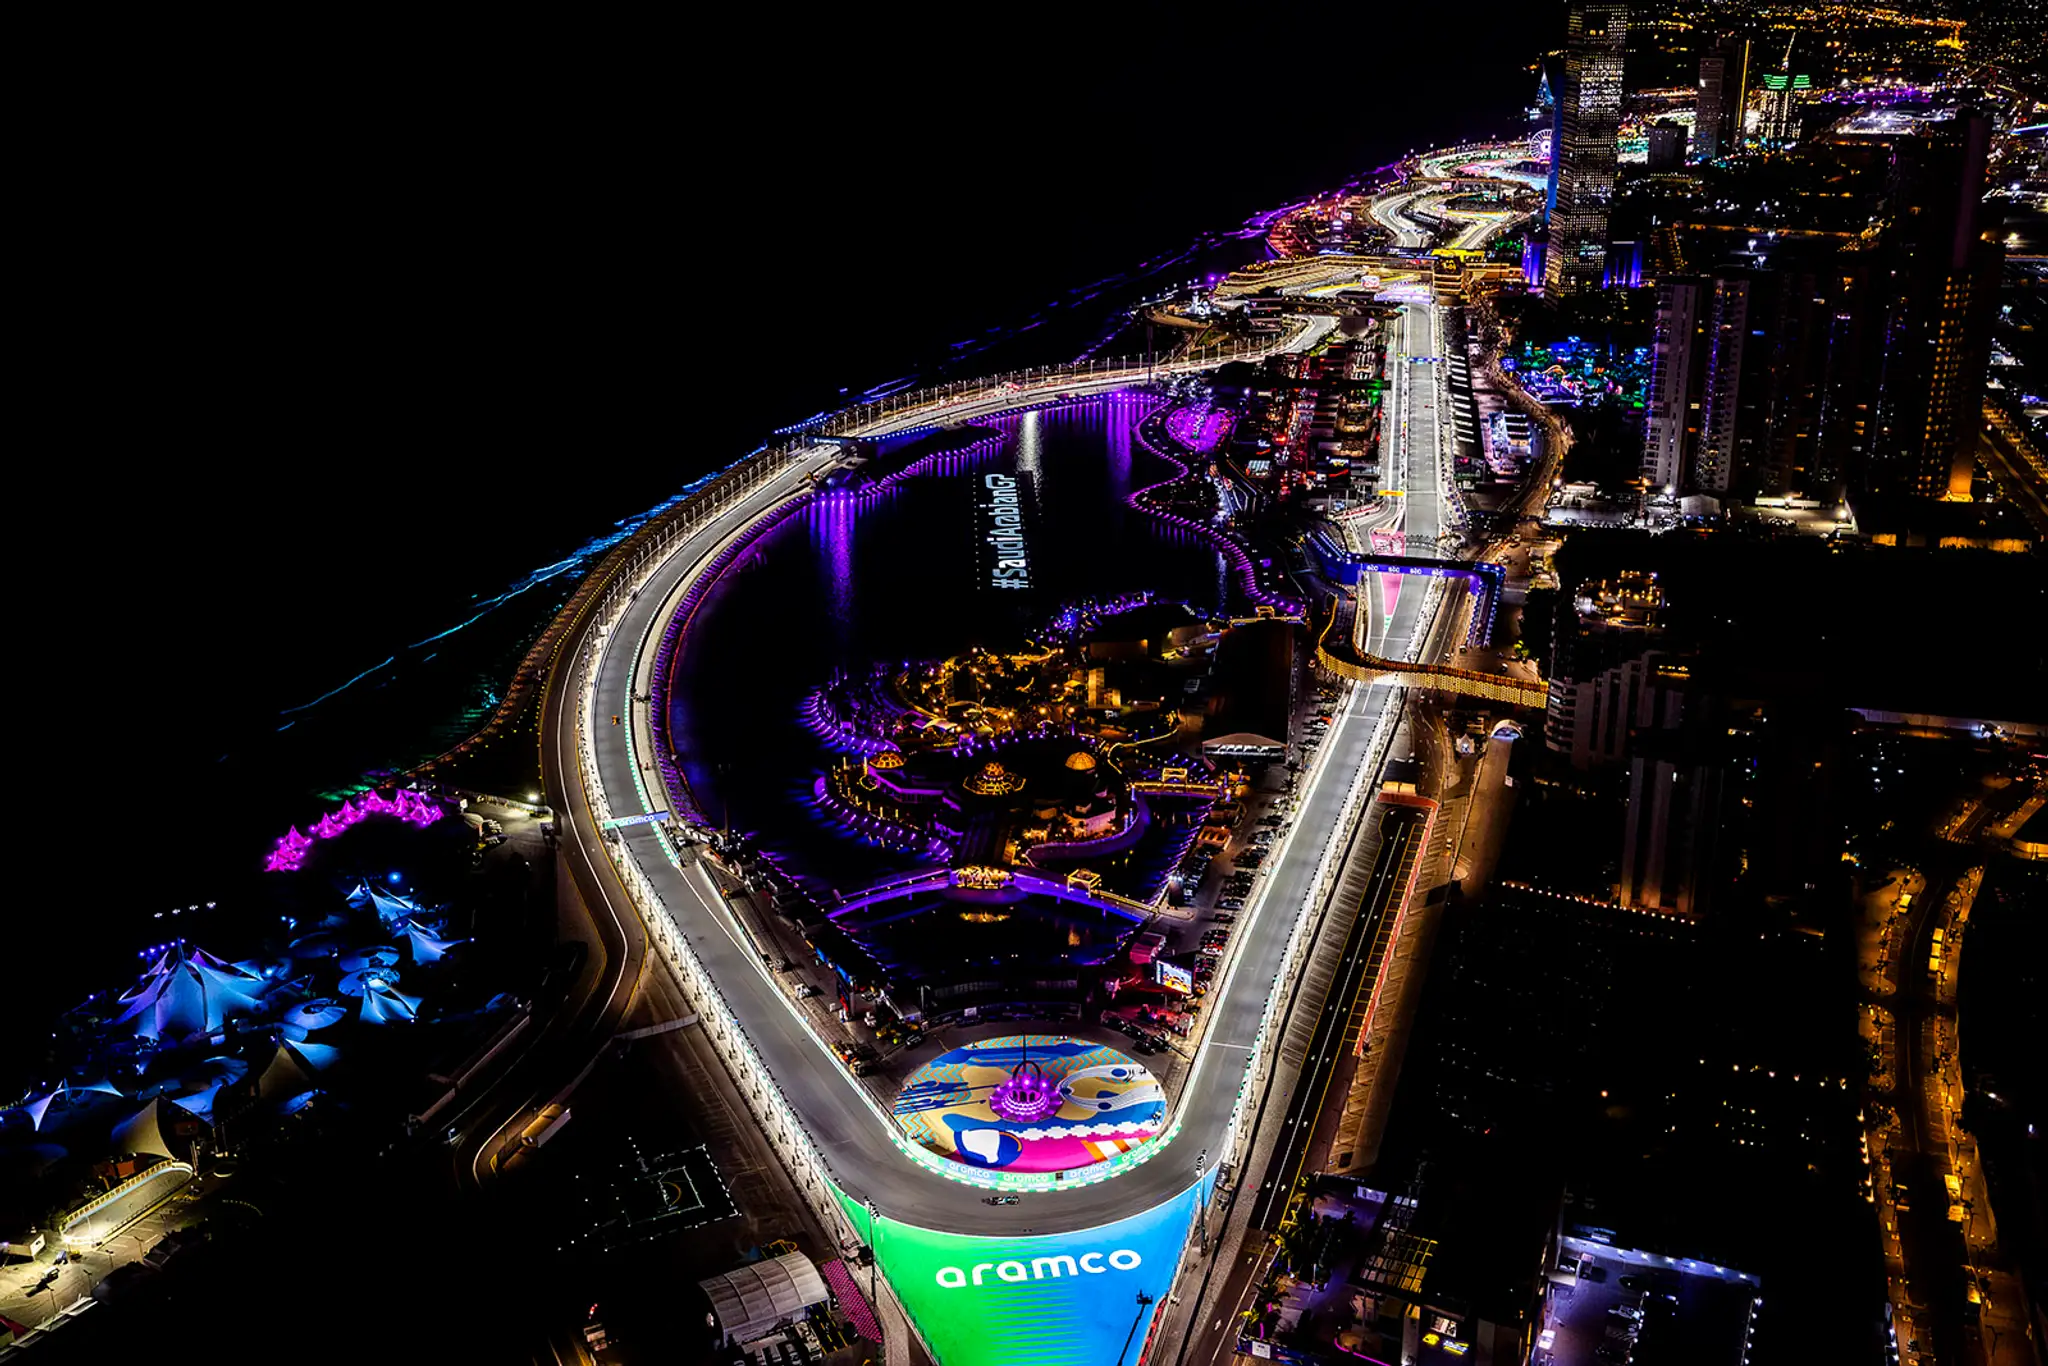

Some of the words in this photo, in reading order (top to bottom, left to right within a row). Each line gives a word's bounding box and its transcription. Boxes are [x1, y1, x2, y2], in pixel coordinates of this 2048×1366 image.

[979, 473, 1029, 589] #SaudiArabianGP
[948, 1161, 990, 1178] aramco
[1003, 1174, 1048, 1183] aramco
[1069, 1161, 1112, 1179] aramco
[935, 1249, 1142, 1288] aramco
